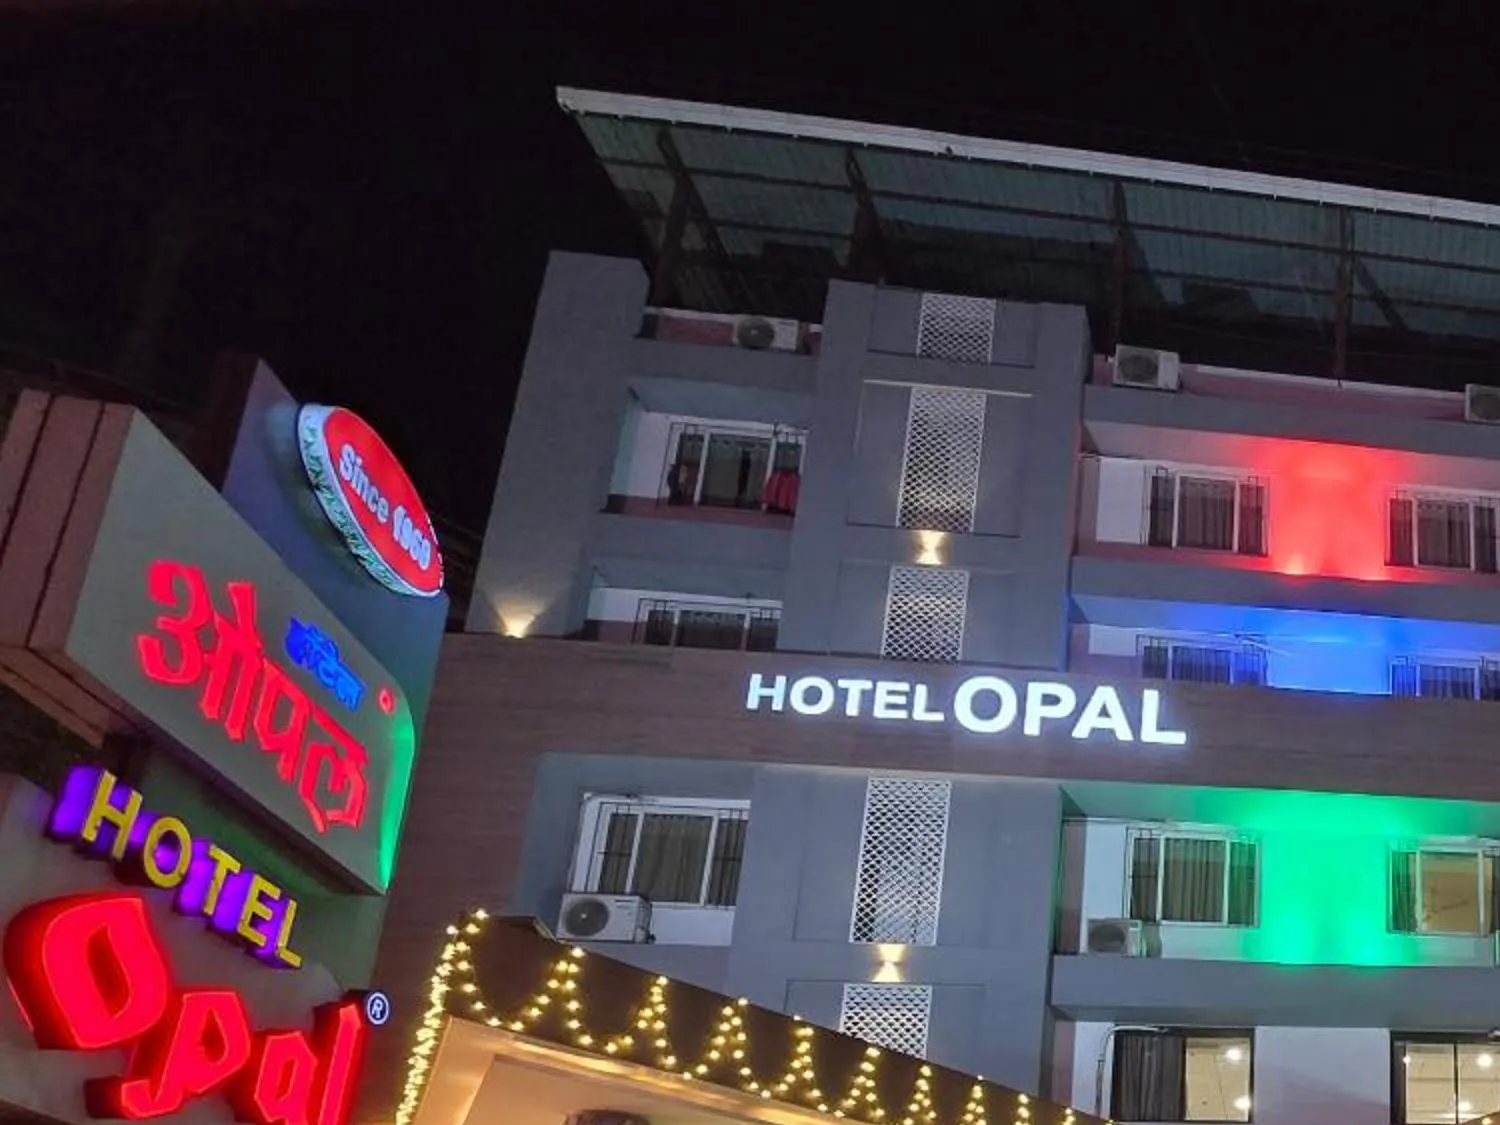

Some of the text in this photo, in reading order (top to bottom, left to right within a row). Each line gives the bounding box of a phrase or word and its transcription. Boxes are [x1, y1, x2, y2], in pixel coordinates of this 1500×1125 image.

[338, 443, 389, 524] Since
[136, 559, 369, 833] ओपल
[745, 672, 1188, 746] HOTEL OPAL
[80, 769, 303, 969] HOTEL
